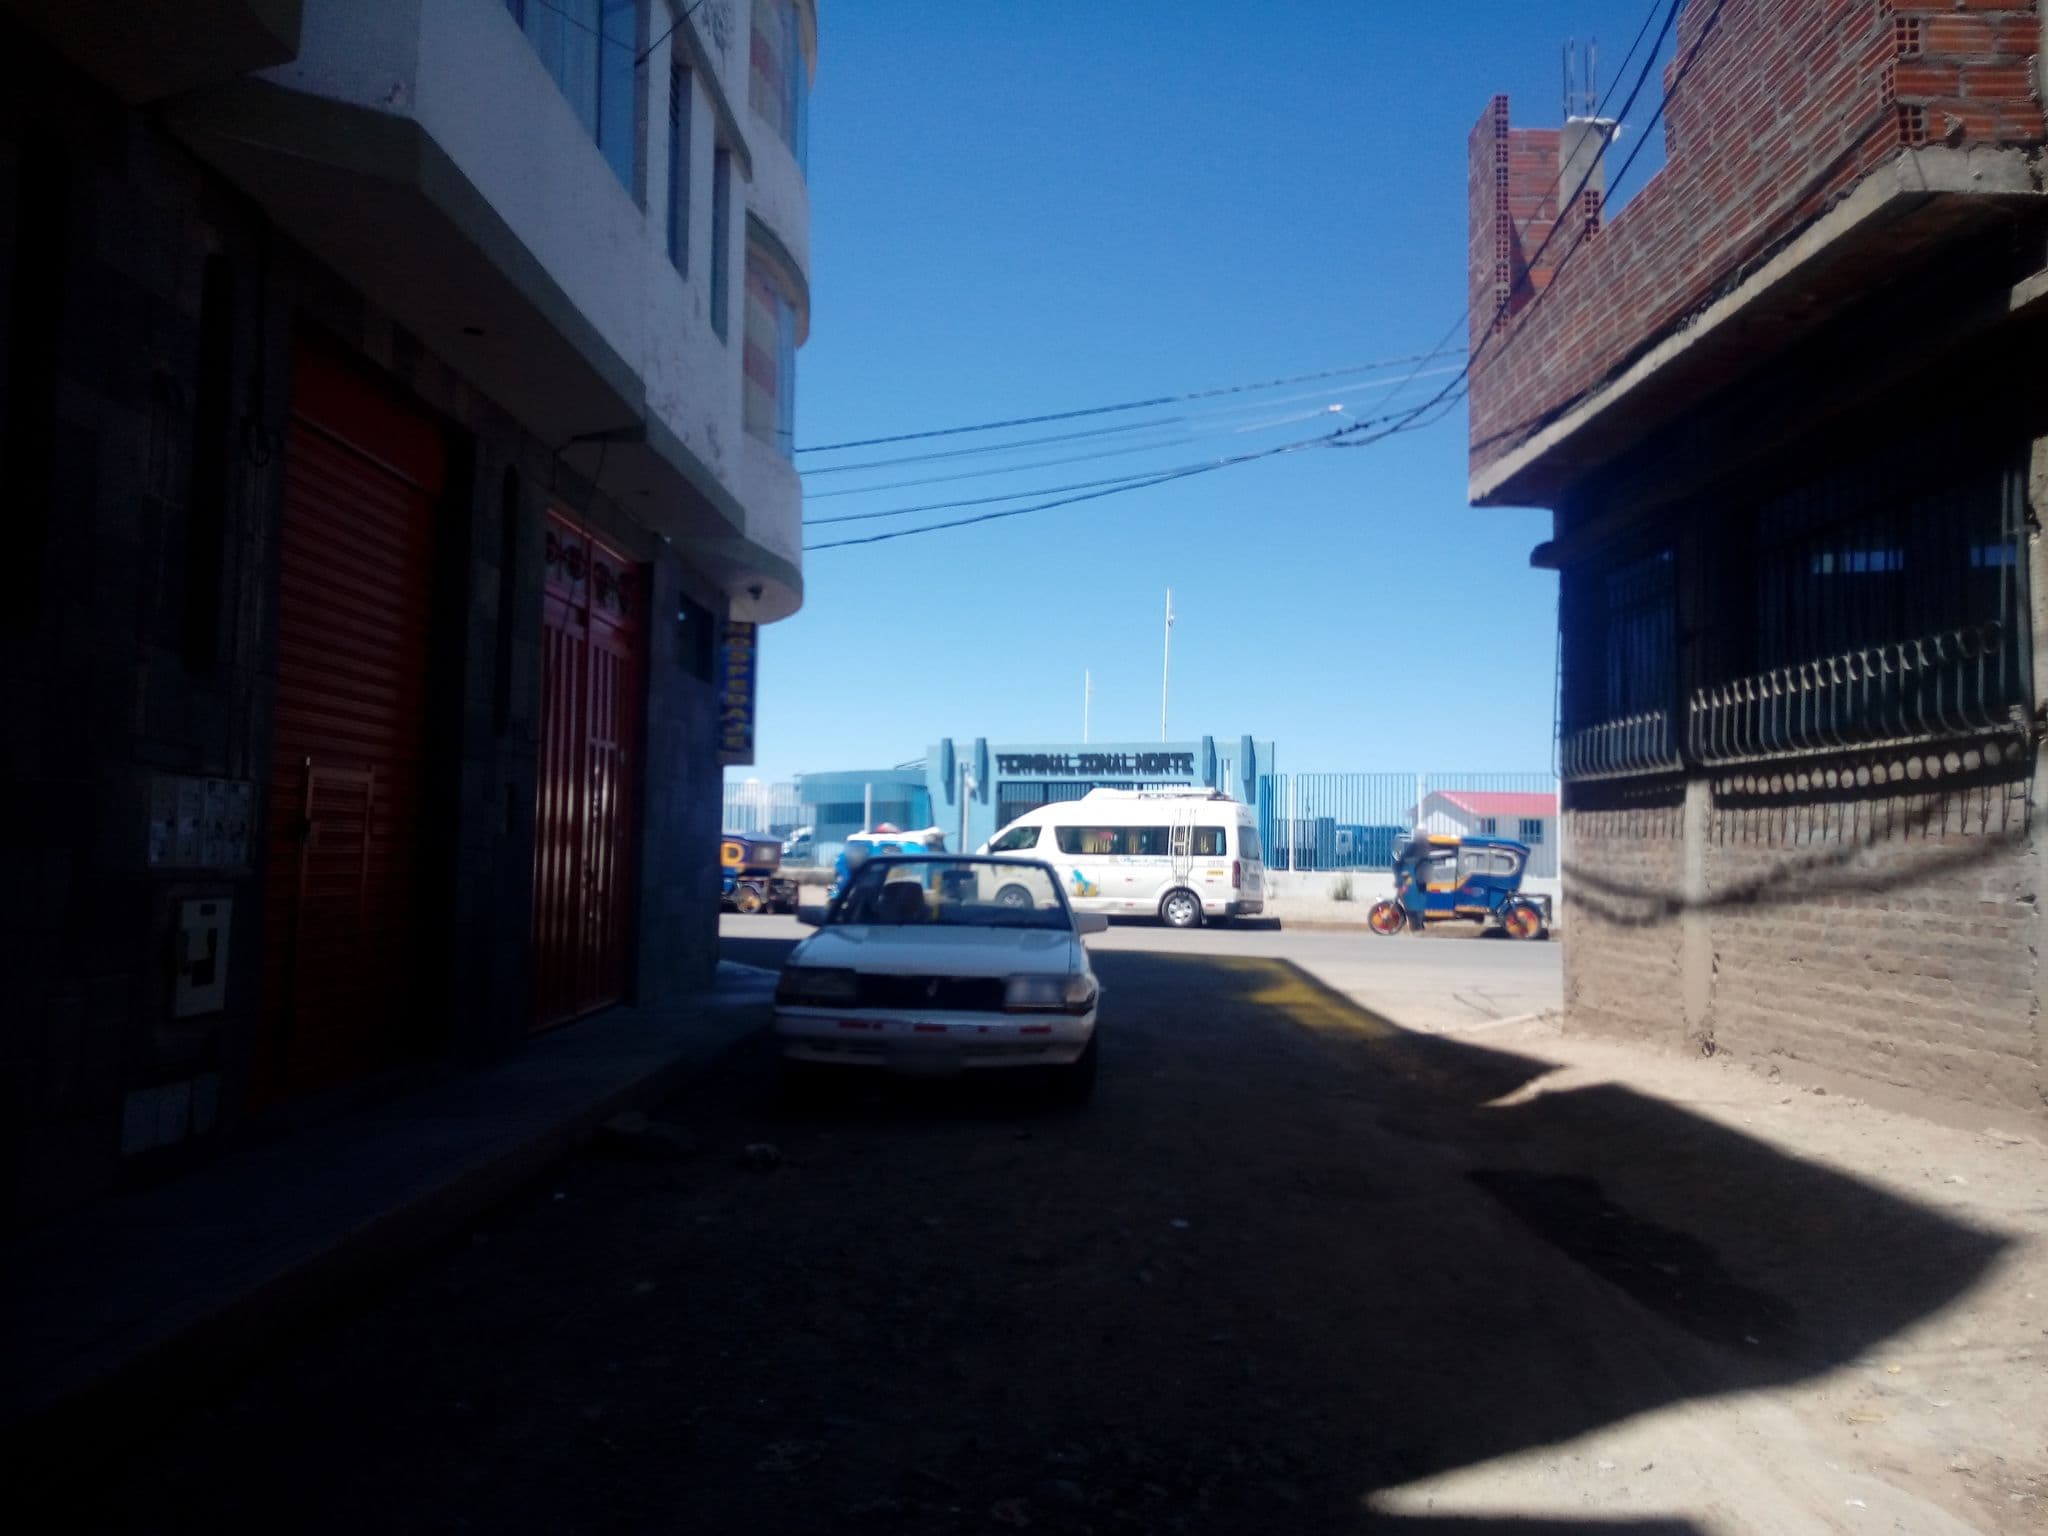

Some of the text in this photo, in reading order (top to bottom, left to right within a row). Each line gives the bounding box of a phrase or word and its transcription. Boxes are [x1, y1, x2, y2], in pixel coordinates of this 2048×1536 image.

[996, 752, 1194, 775] TERMINAL ZONAL NORTE
